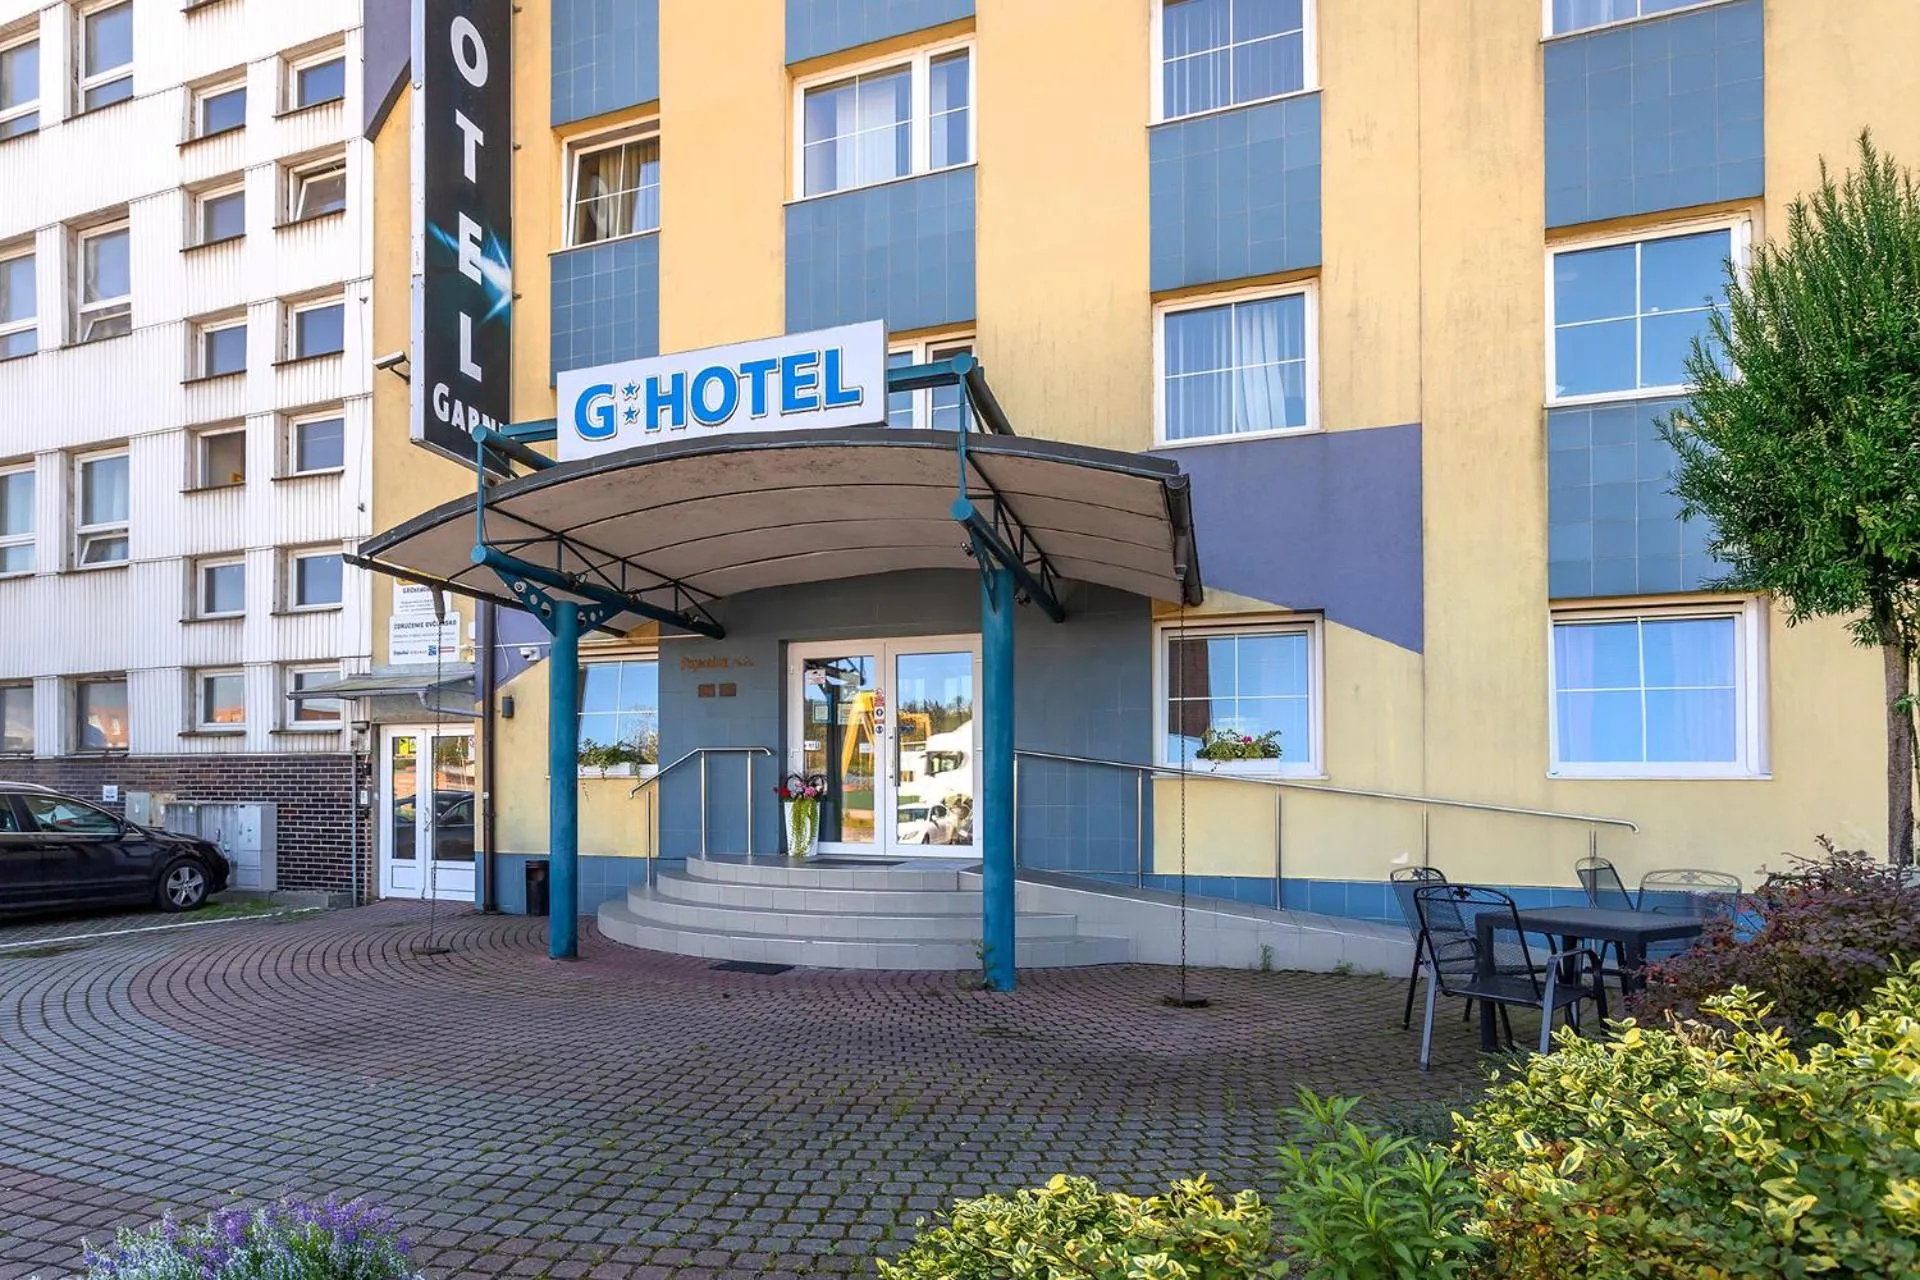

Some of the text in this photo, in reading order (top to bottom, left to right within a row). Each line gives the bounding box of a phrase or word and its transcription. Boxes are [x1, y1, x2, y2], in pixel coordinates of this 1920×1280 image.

[433, 382, 504, 436] GAR
[574, 347, 863, 441] G HOTEL
